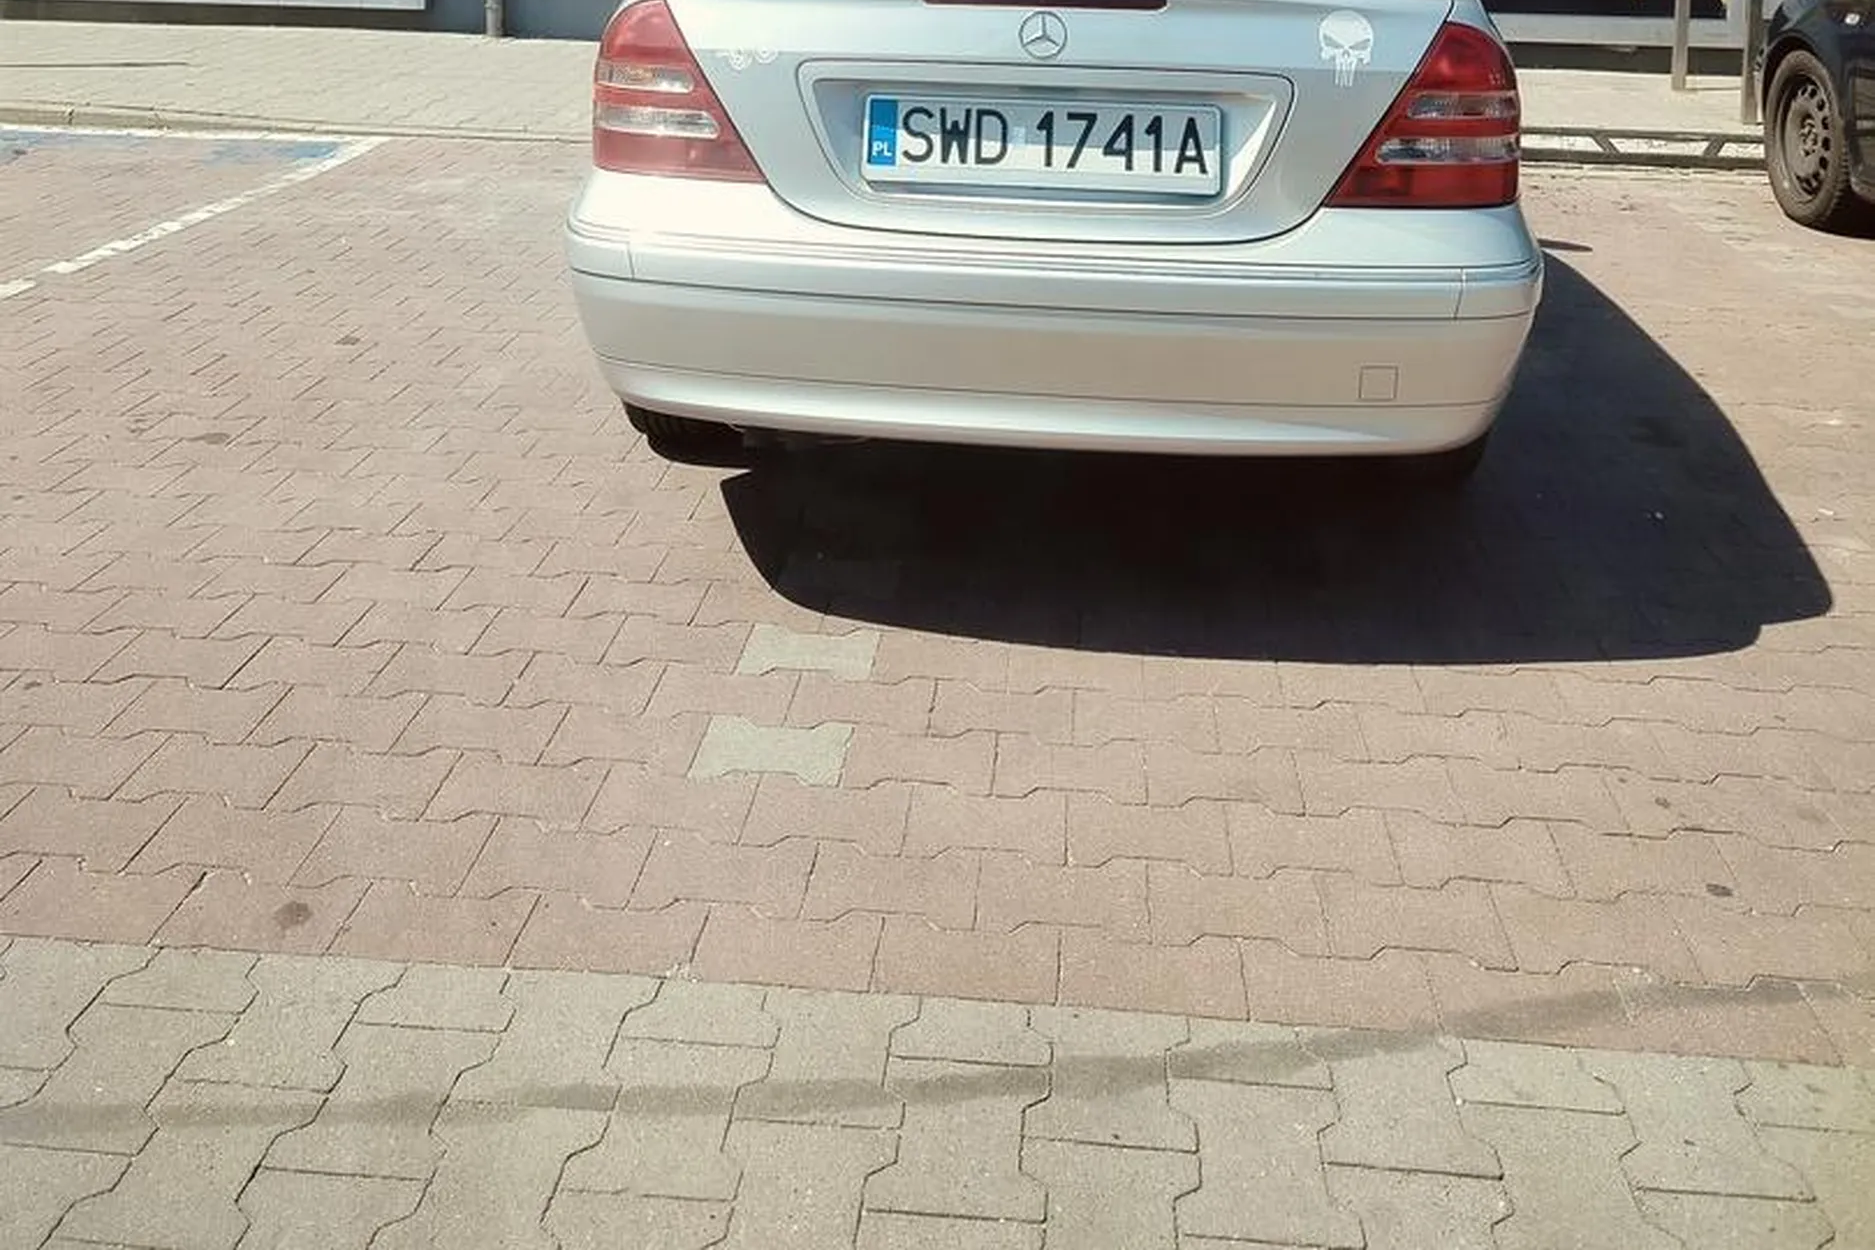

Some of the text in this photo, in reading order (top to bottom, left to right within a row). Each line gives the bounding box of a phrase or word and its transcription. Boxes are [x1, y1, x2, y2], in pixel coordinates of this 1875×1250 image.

[872, 106, 1208, 175] PL SWD 1741A
